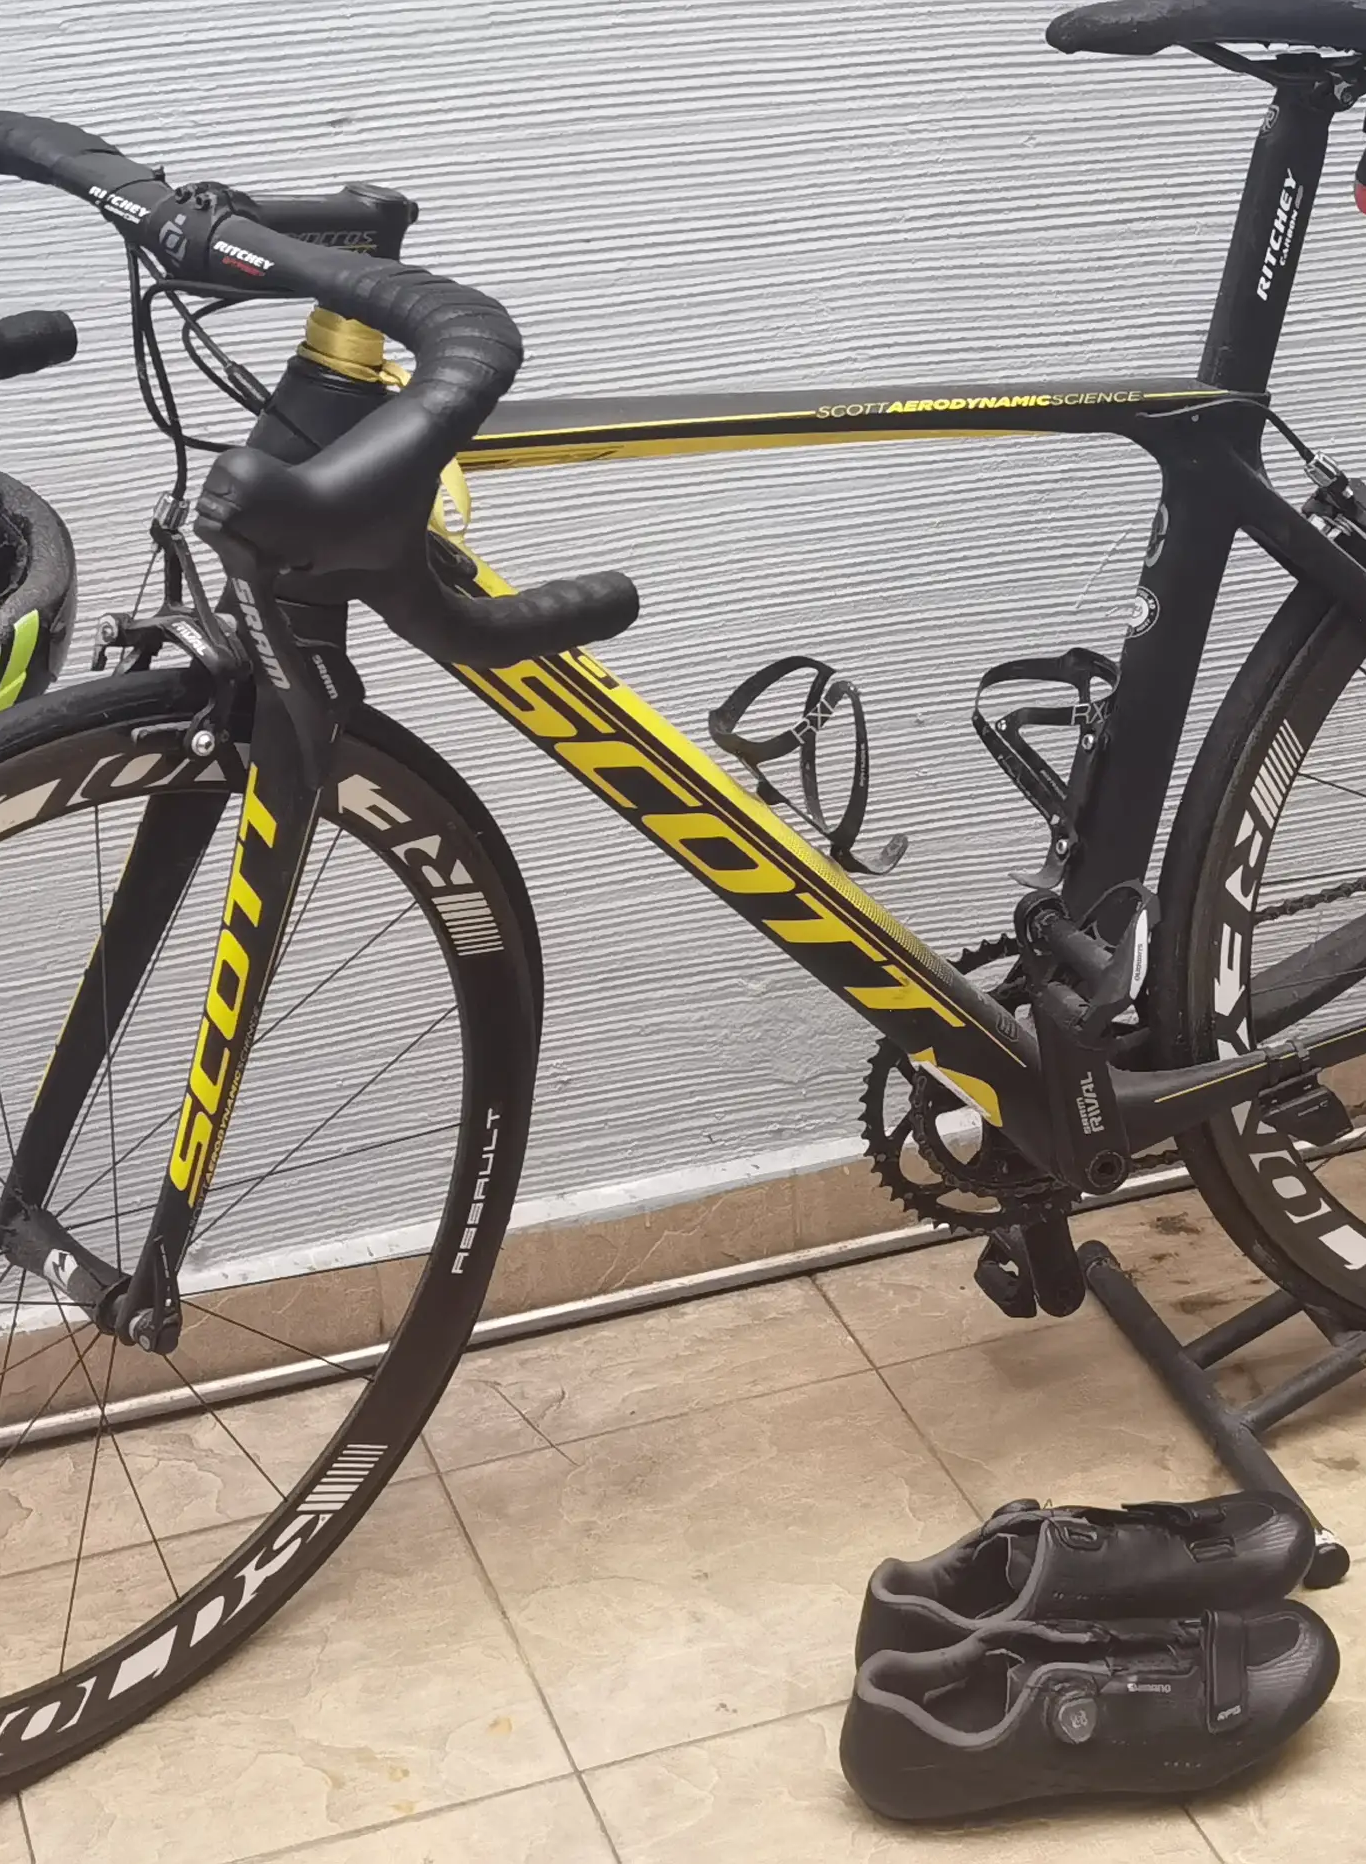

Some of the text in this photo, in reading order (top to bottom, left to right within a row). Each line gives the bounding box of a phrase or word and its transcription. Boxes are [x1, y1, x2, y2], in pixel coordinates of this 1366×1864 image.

[213, 241, 274, 270] RITCHEY
[1256, 168, 1296, 301] RITCHEY
[1279, 209, 1298, 266] CARBON
[233, 577, 290, 690] SRAM
[454, 656, 965, 1028] SCOTT
[169, 763, 279, 1209] SCOTT
[1080, 1072, 1105, 1133] RIVAL
[451, 1108, 501, 1274] ASSAULT
